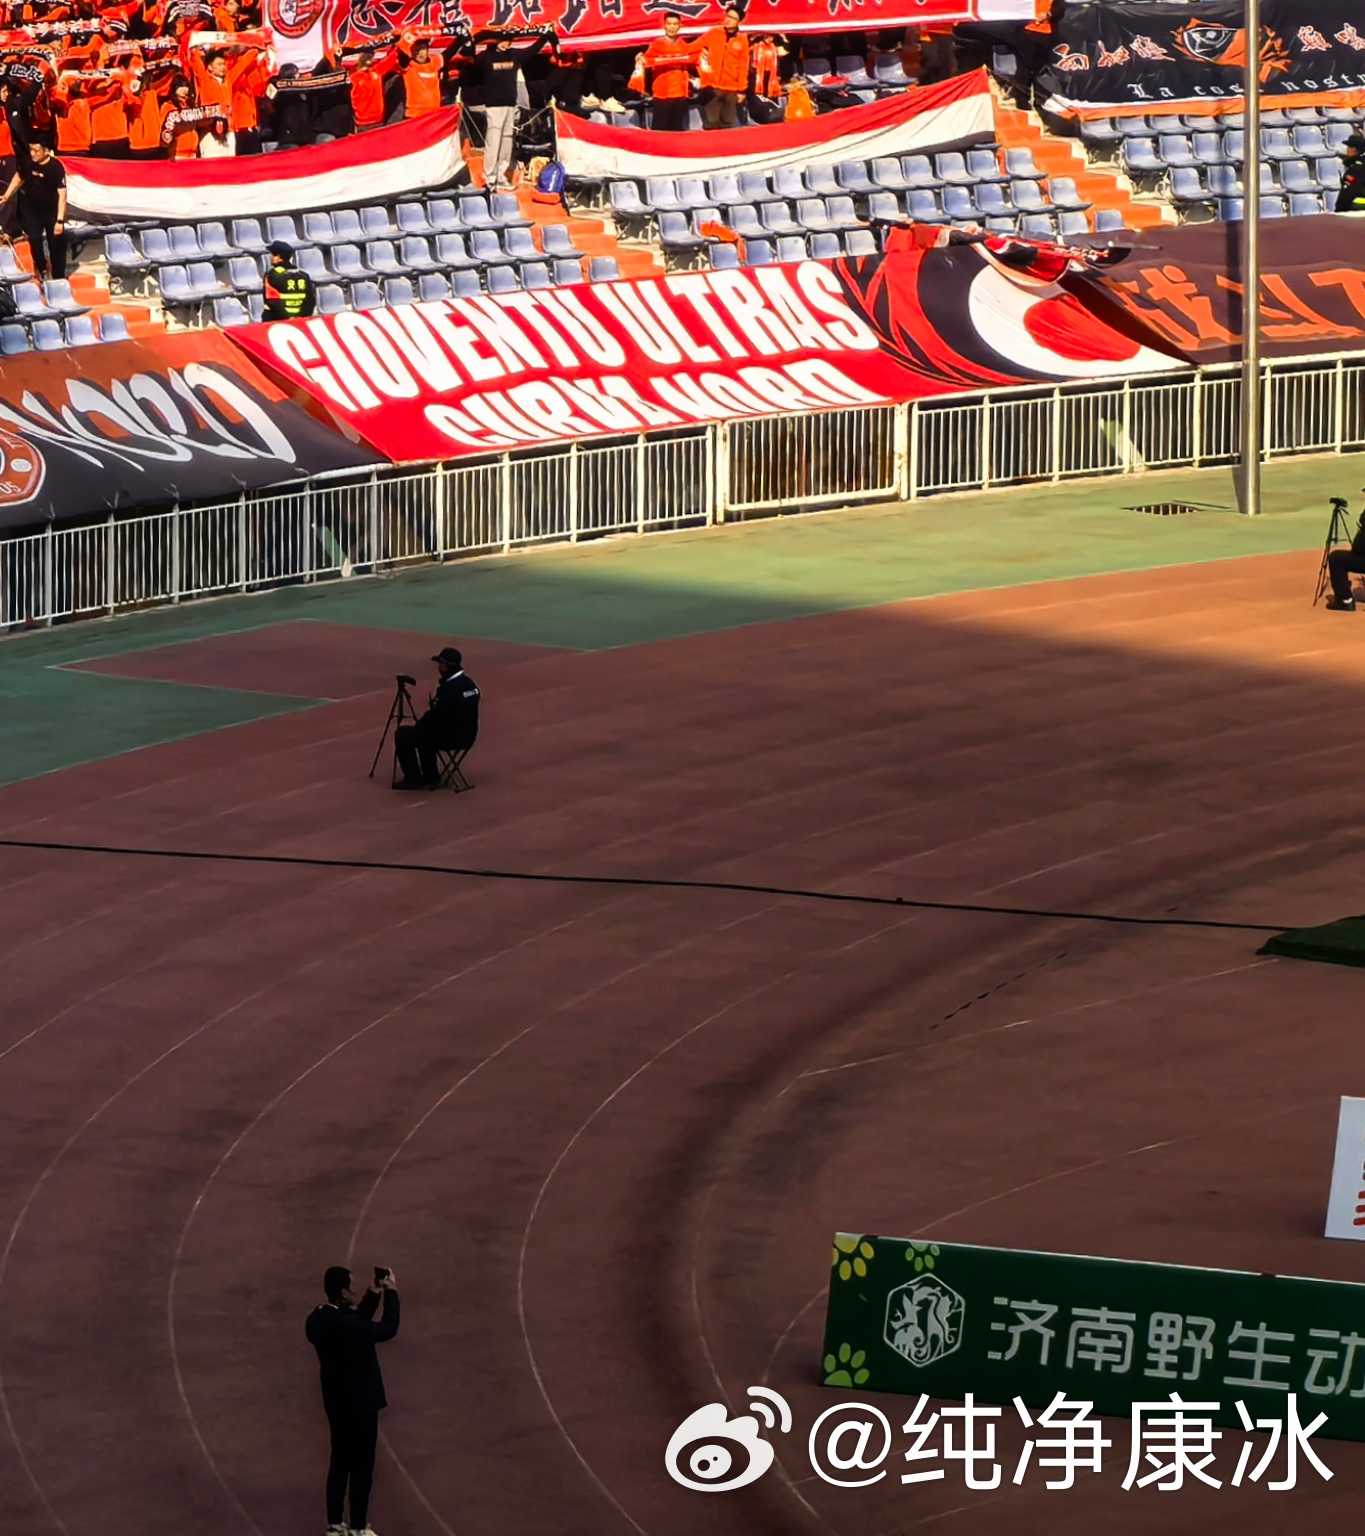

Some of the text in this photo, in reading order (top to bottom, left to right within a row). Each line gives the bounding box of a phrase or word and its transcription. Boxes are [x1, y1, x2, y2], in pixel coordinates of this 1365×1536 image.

[266, 261, 878, 412] GIOVENTU ULTRAS
[987, 1295, 1365, 1398] 济南野生动
